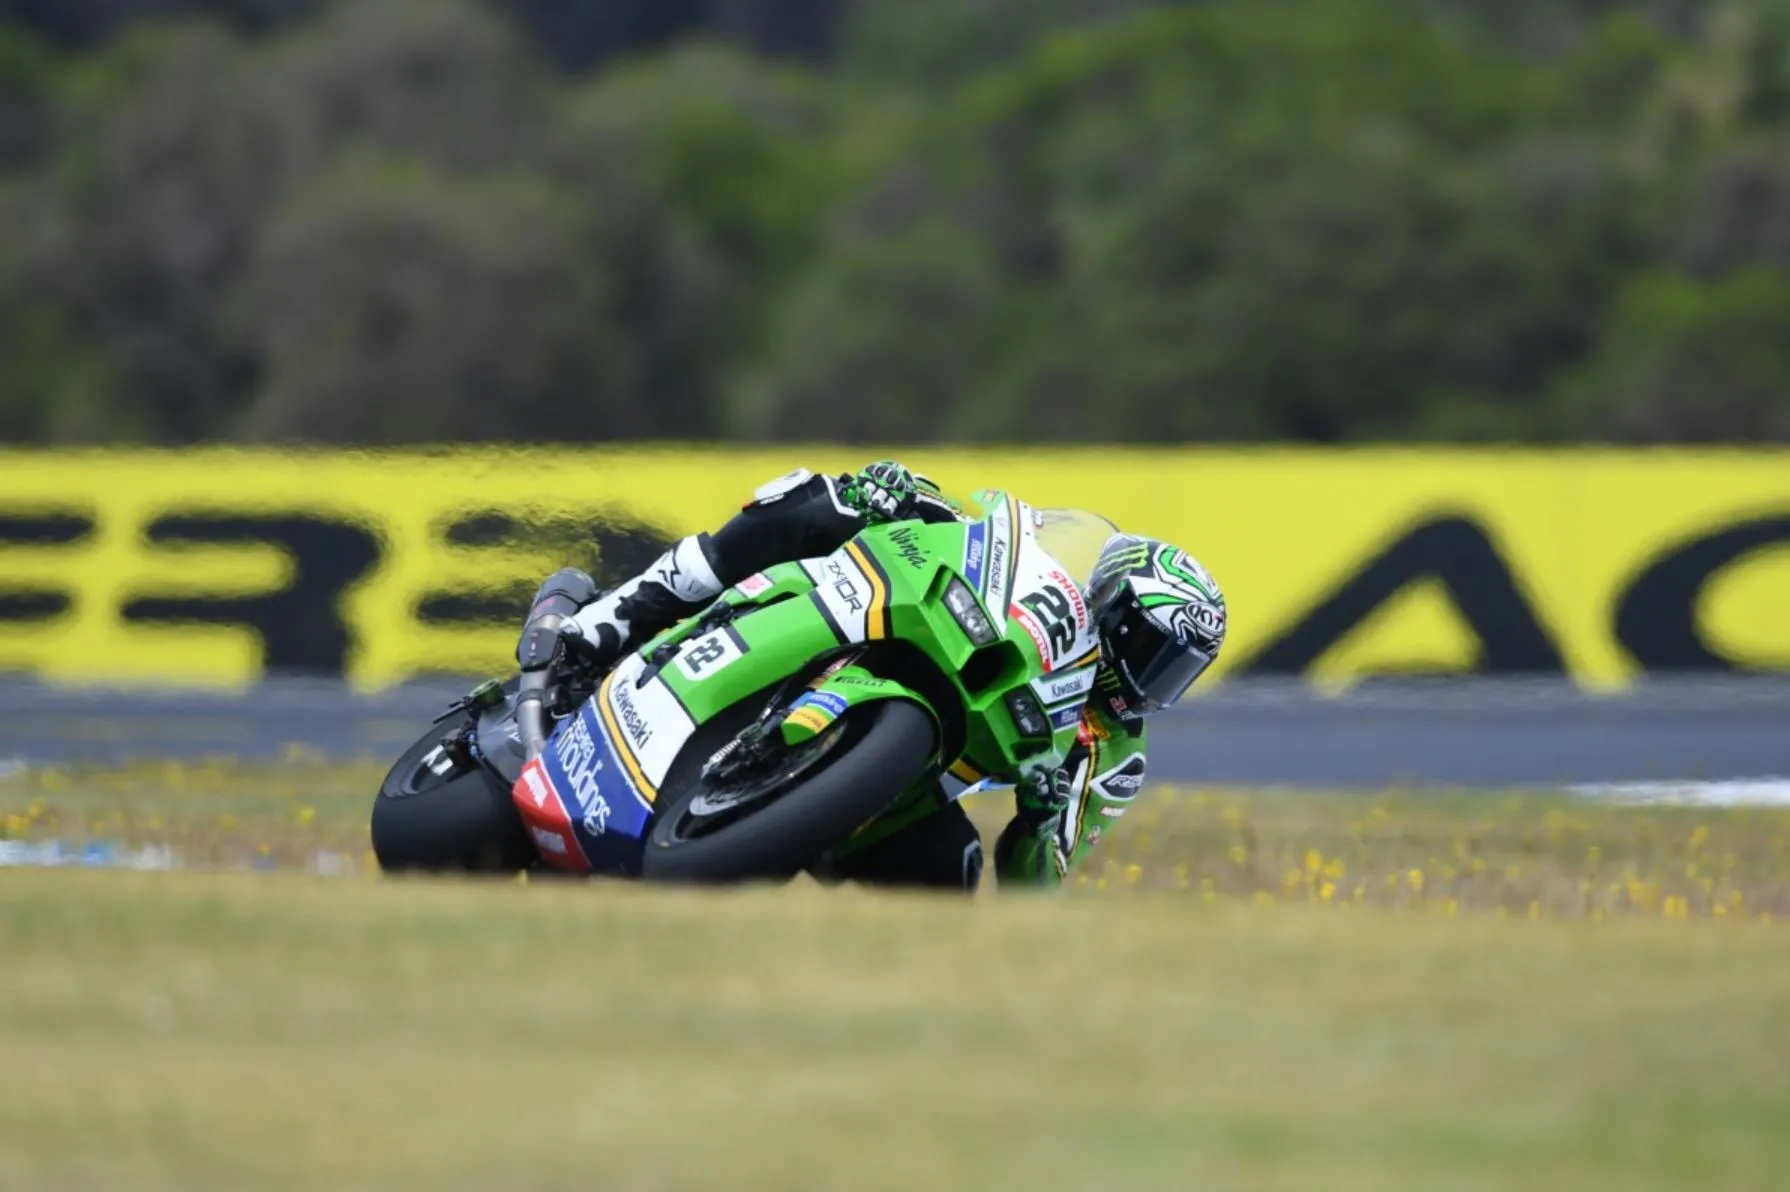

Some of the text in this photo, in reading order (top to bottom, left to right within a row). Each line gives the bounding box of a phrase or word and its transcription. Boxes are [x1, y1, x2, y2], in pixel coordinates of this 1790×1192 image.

[888, 527, 931, 570] Ninja
[990, 536, 1007, 597] Kawasaki
[1019, 585, 1077, 662] 22
[1048, 570, 1086, 631] SHOWA
[684, 636, 726, 675] 22
[613, 672, 654, 751] Kawasaki
